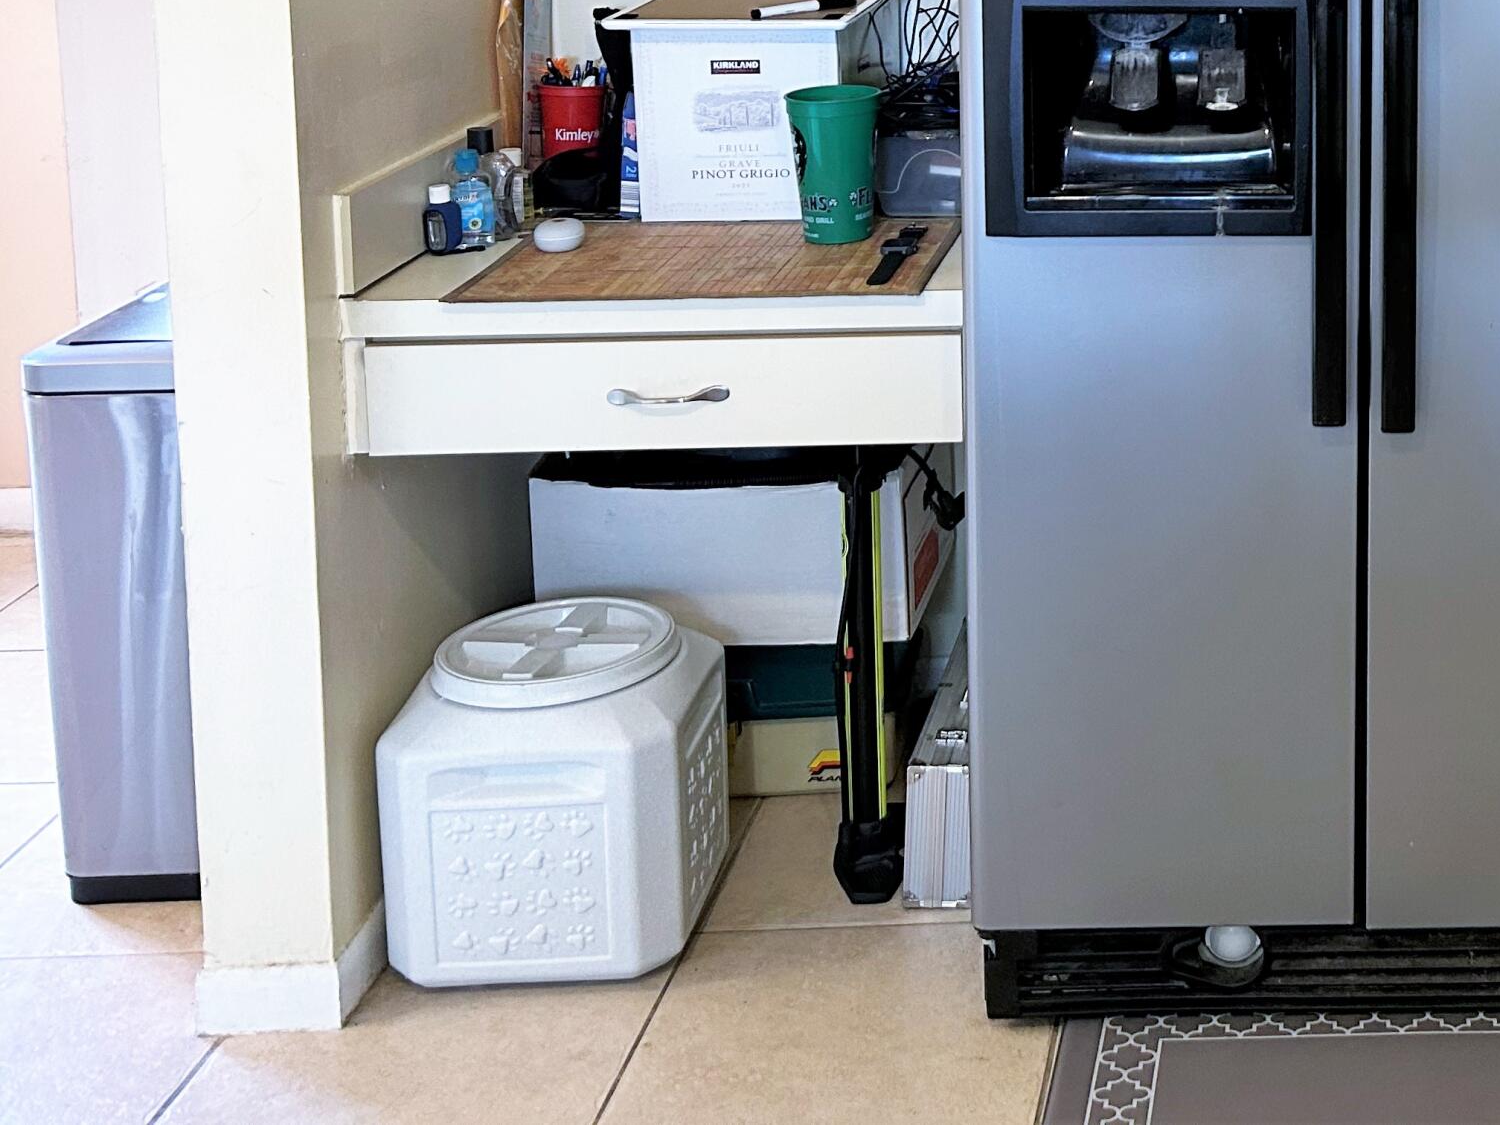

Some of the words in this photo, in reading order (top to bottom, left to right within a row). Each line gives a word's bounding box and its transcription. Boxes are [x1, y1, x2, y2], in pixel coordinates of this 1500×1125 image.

[713, 61, 759, 70] KIRKLAND
[718, 144, 760, 153] FRIULI
[718, 159, 762, 168] GRAVE
[691, 170, 736, 180] PINOT
[739, 169, 791, 179] GRIGIO
